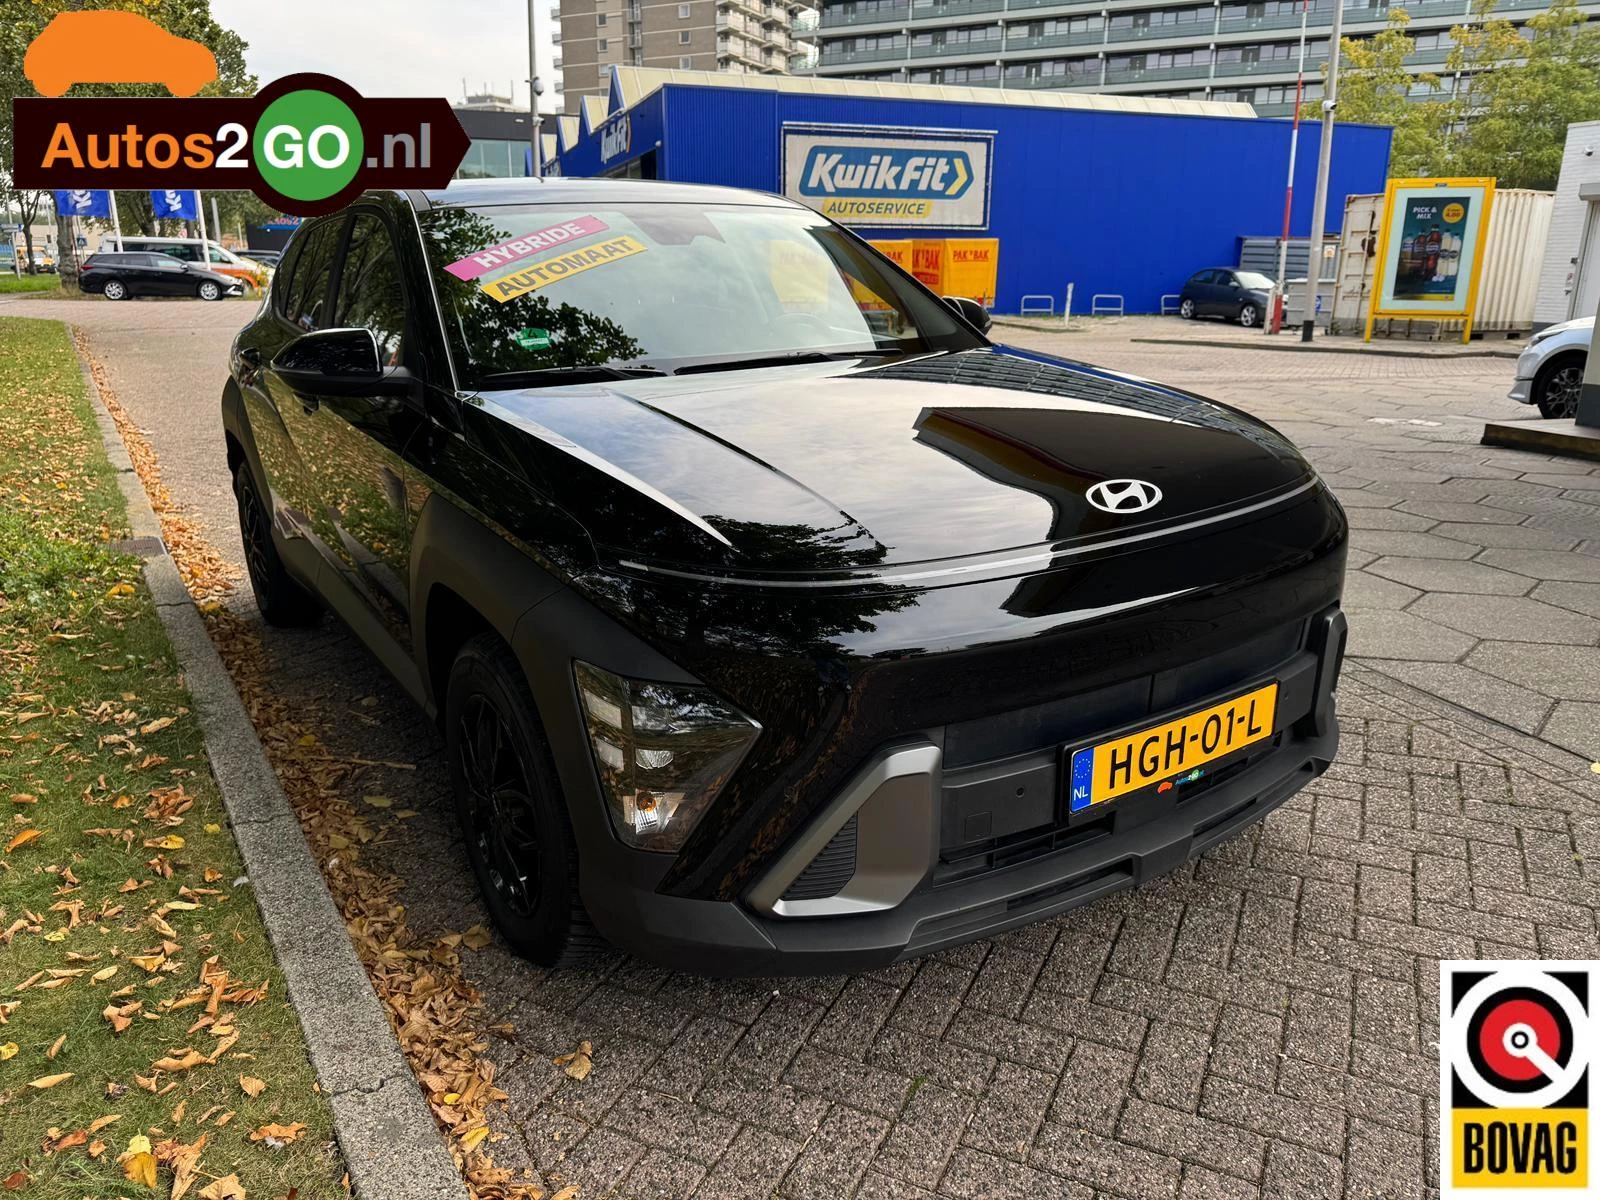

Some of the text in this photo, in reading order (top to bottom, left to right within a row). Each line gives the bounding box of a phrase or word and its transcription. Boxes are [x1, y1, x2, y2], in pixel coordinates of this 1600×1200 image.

[827, 201, 926, 215] AUTOSERVICE
[473, 222, 587, 269] HYBRIDE
[495, 239, 634, 297] AUTOMAAT
[1109, 699, 1262, 790] HGH-01-L
[1073, 785, 1089, 801] NL
